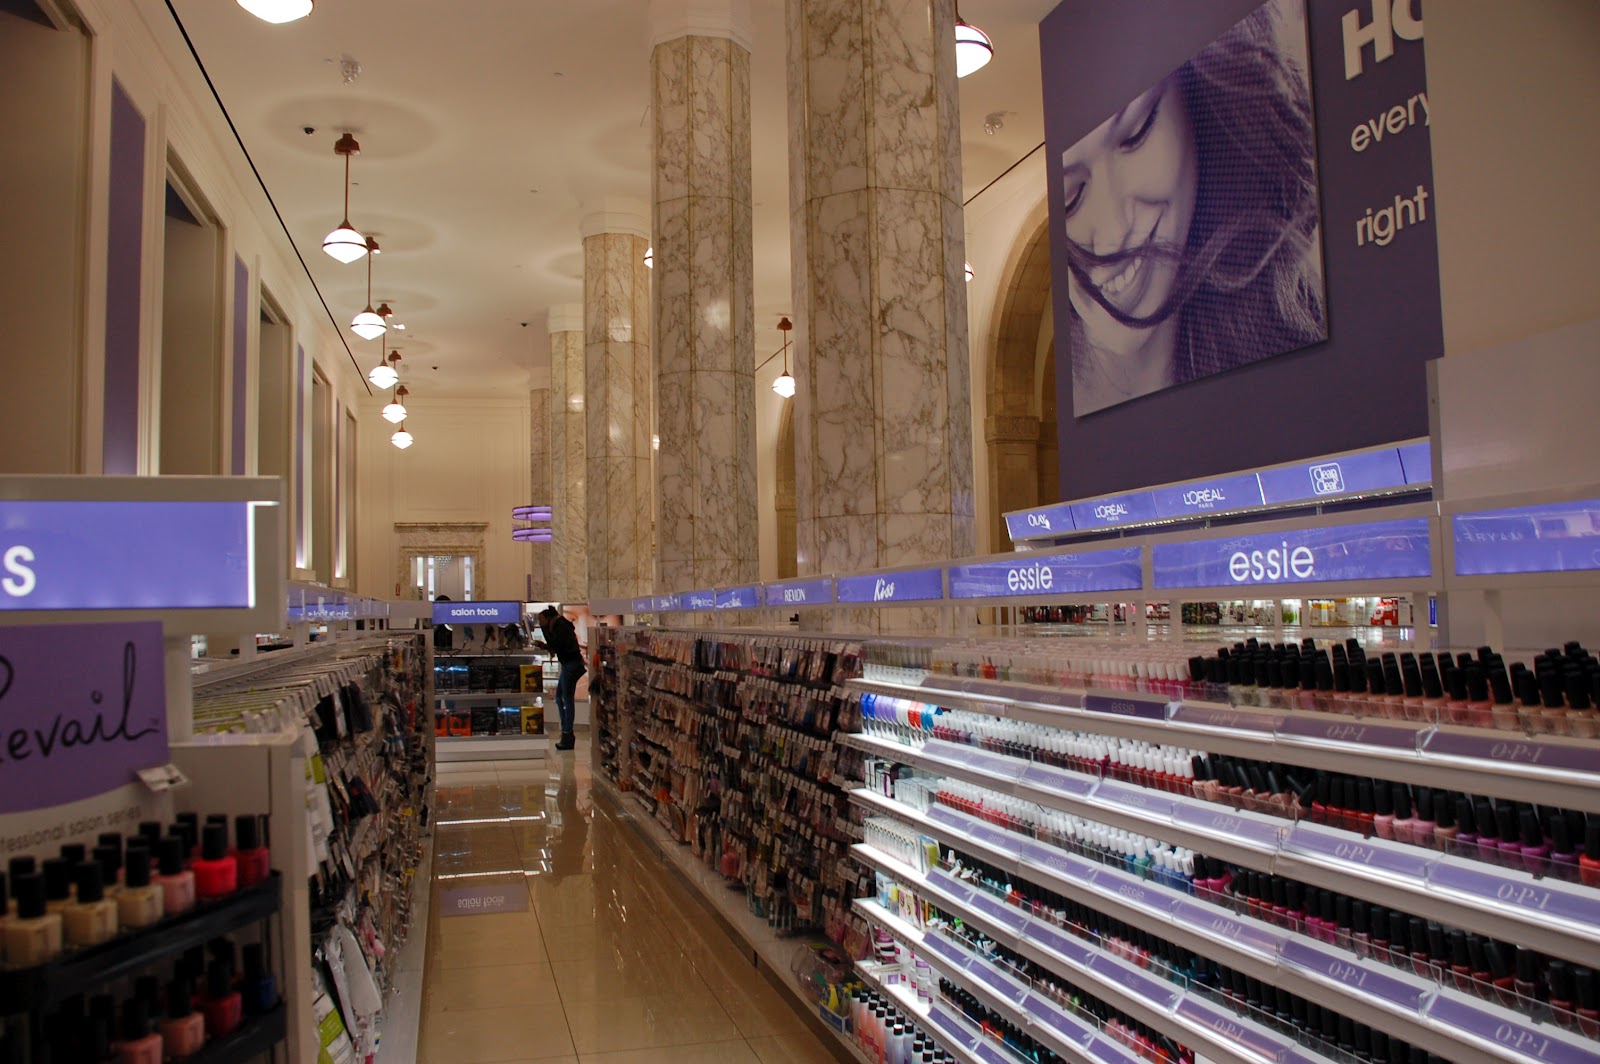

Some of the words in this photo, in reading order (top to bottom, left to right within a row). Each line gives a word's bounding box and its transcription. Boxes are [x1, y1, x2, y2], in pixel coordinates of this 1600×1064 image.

[1356, 185, 1429, 247] right
[1313, 467, 1339, 482] Clean
[1316, 480, 1340, 493] Clear
[1229, 540, 1316, 582] essie
[1007, 562, 1054, 591] essie
[784, 588, 806, 602] REVLON
[874, 578, 895, 602] Kiss
[451, 607, 476, 616] salon
[477, 607, 499, 616] tools
[1110, 701, 1136, 716] essie
[1118, 883, 1145, 900] essie
